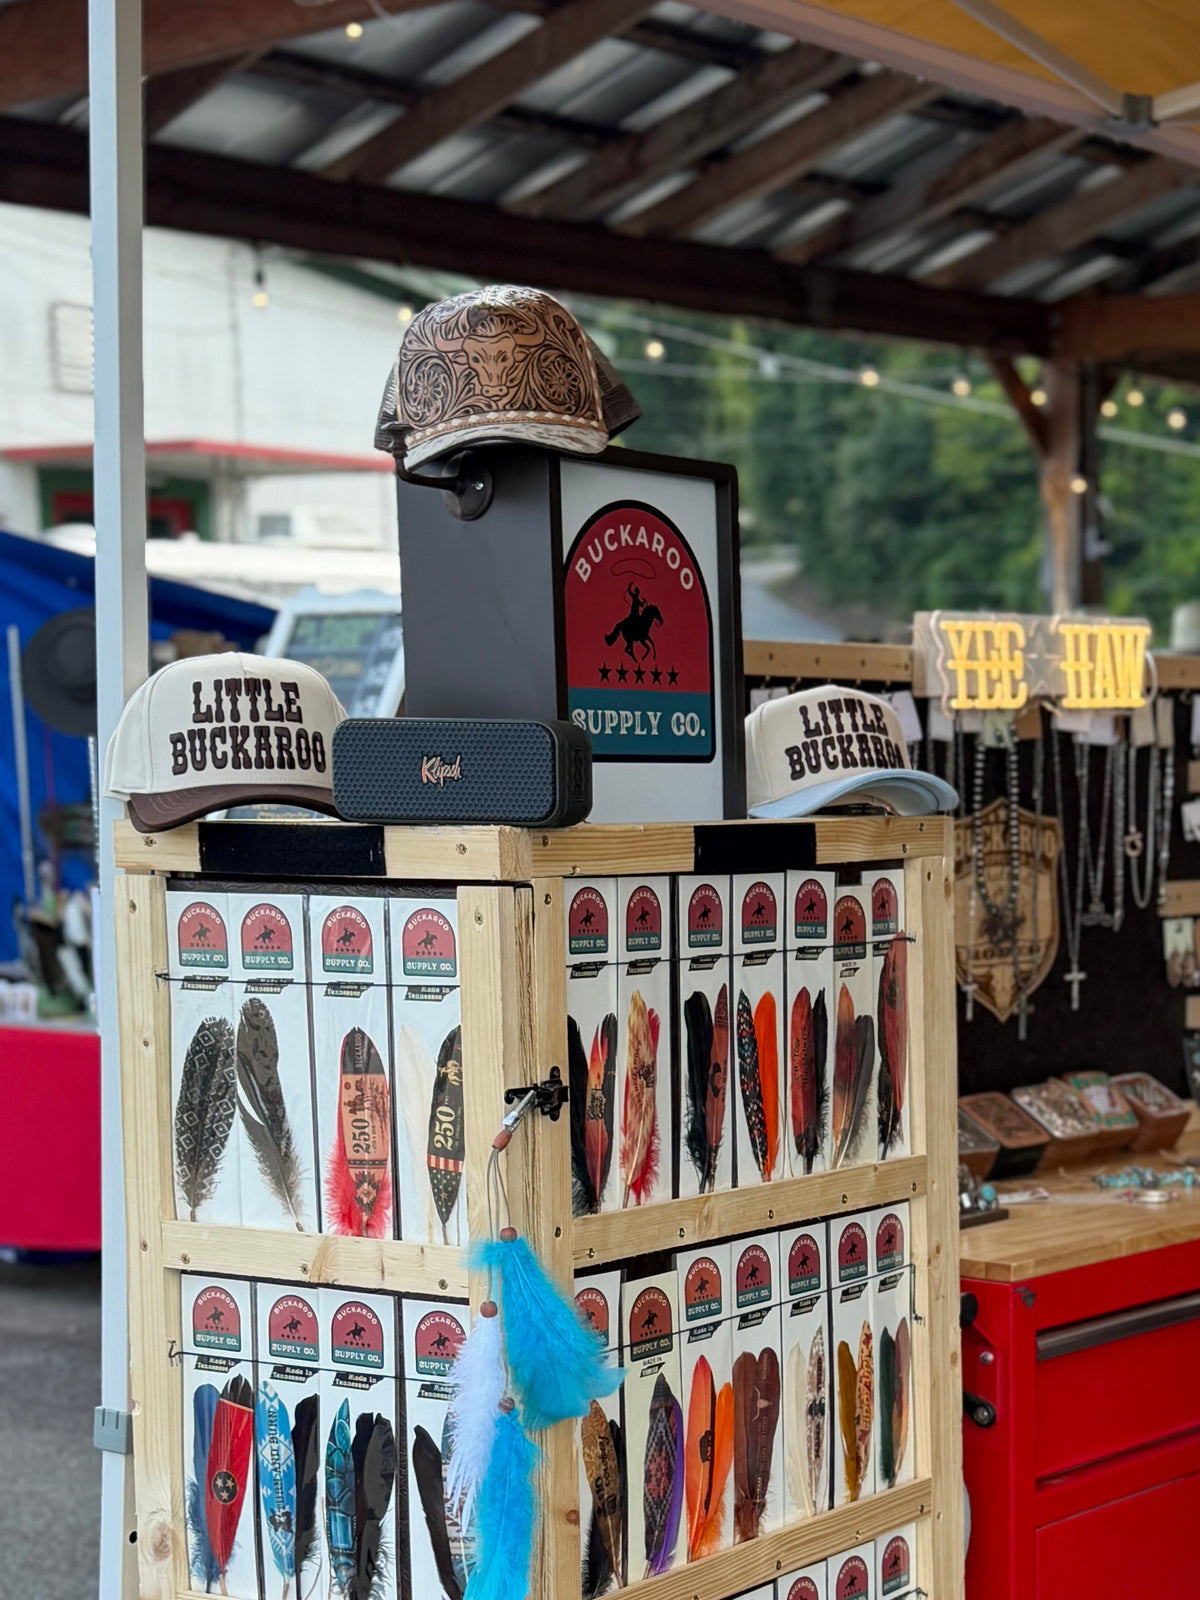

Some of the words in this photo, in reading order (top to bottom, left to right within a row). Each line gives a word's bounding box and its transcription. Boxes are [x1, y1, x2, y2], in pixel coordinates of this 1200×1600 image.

[574, 523, 694, 591] BUCKAROO
[940, 620, 1028, 710] YEE
[1058, 624, 1151, 709] HAW
[192, 677, 304, 724] LITTLE
[572, 708, 663, 736] SUPPLY
[671, 711, 706, 738] CO.
[798, 697, 889, 739] LITTLE
[169, 725, 327, 776] BUCKAROO
[784, 733, 905, 781] BUCKAROO
[421, 754, 462, 788] Klipsch
[630, 891, 658, 908] BUCKAROO
[692, 889, 719, 905] BUCKAROO
[745, 886, 774, 903] BUCKAROO
[798, 883, 824, 899] BUCKAROO
[573, 892, 604, 910] BUCKAROO
[182, 907, 221, 924] BUCKAROO
[245, 908, 286, 926] BUCKAROO
[326, 910, 366, 929] BUCKAROO
[407, 913, 449, 931] BUCKAROO
[628, 937, 648, 945] SUPPLY
[690, 934, 711, 942] SUPPLY
[712, 933, 720, 941] CO.
[744, 930, 764, 939] SUPPLY
[766, 929, 775, 937] CO.
[571, 939, 594, 948] SUPPLY
[596, 939, 606, 947] CO.
[181, 953, 210, 962] SUPPLY
[245, 955, 275, 964] SUPPLY
[326, 959, 356, 967] SUPPLY
[358, 960, 370, 968] CO.
[406, 961, 437, 970] SUPPLY
[440, 963, 454, 971] CO.
[351, 1118, 371, 1154] 250
[433, 1105, 456, 1151] 250
[841, 1227, 865, 1244] BUCKAROO
[791, 1239, 816, 1255] BUCKAROO
[739, 1250, 767, 1268] BUCKAROO
[688, 1262, 718, 1280] BUCKAROO
[840, 1266, 858, 1276] SUPPLY
[790, 1281, 810, 1290] SUPPLY
[198, 1291, 235, 1309] BUCKAROO
[634, 1293, 667, 1314] BUCKAROO
[739, 1291, 759, 1302] SUPPLY
[760, 1289, 769, 1297] CO.
[274, 1301, 313, 1318] BUCKAROO
[336, 1307, 377, 1325] BUCKAROO
[688, 1304, 709, 1315] SUPPLY
[420, 1316, 462, 1334] BUCKAROO
[693, 1327, 707, 1335] Made
[196, 1334, 224, 1344] SUPPLY
[226, 1337, 239, 1346] CO.
[632, 1341, 658, 1355] SUPPLY
[660, 1338, 671, 1347] CO.
[272, 1343, 301, 1353] SUPPLY
[303, 1347, 316, 1356] CO.
[334, 1349, 365, 1361] SUPPLY
[367, 1354, 381, 1363] CO.
[197, 1362, 228, 1372] Tennessee
[208, 1357, 226, 1365] Made
[419, 1361, 450, 1372] SUPPLY
[272, 1372, 306, 1381] Tennessee
[285, 1366, 303, 1375] Made
[348, 1374, 367, 1383] Made
[335, 1378, 369, 1389] Tennessee
[267, 1410, 279, 1444] BURN
[269, 1449, 281, 1473] AND
[272, 1478, 286, 1511] TURN
[839, 1560, 865, 1579] BUCKAROO
